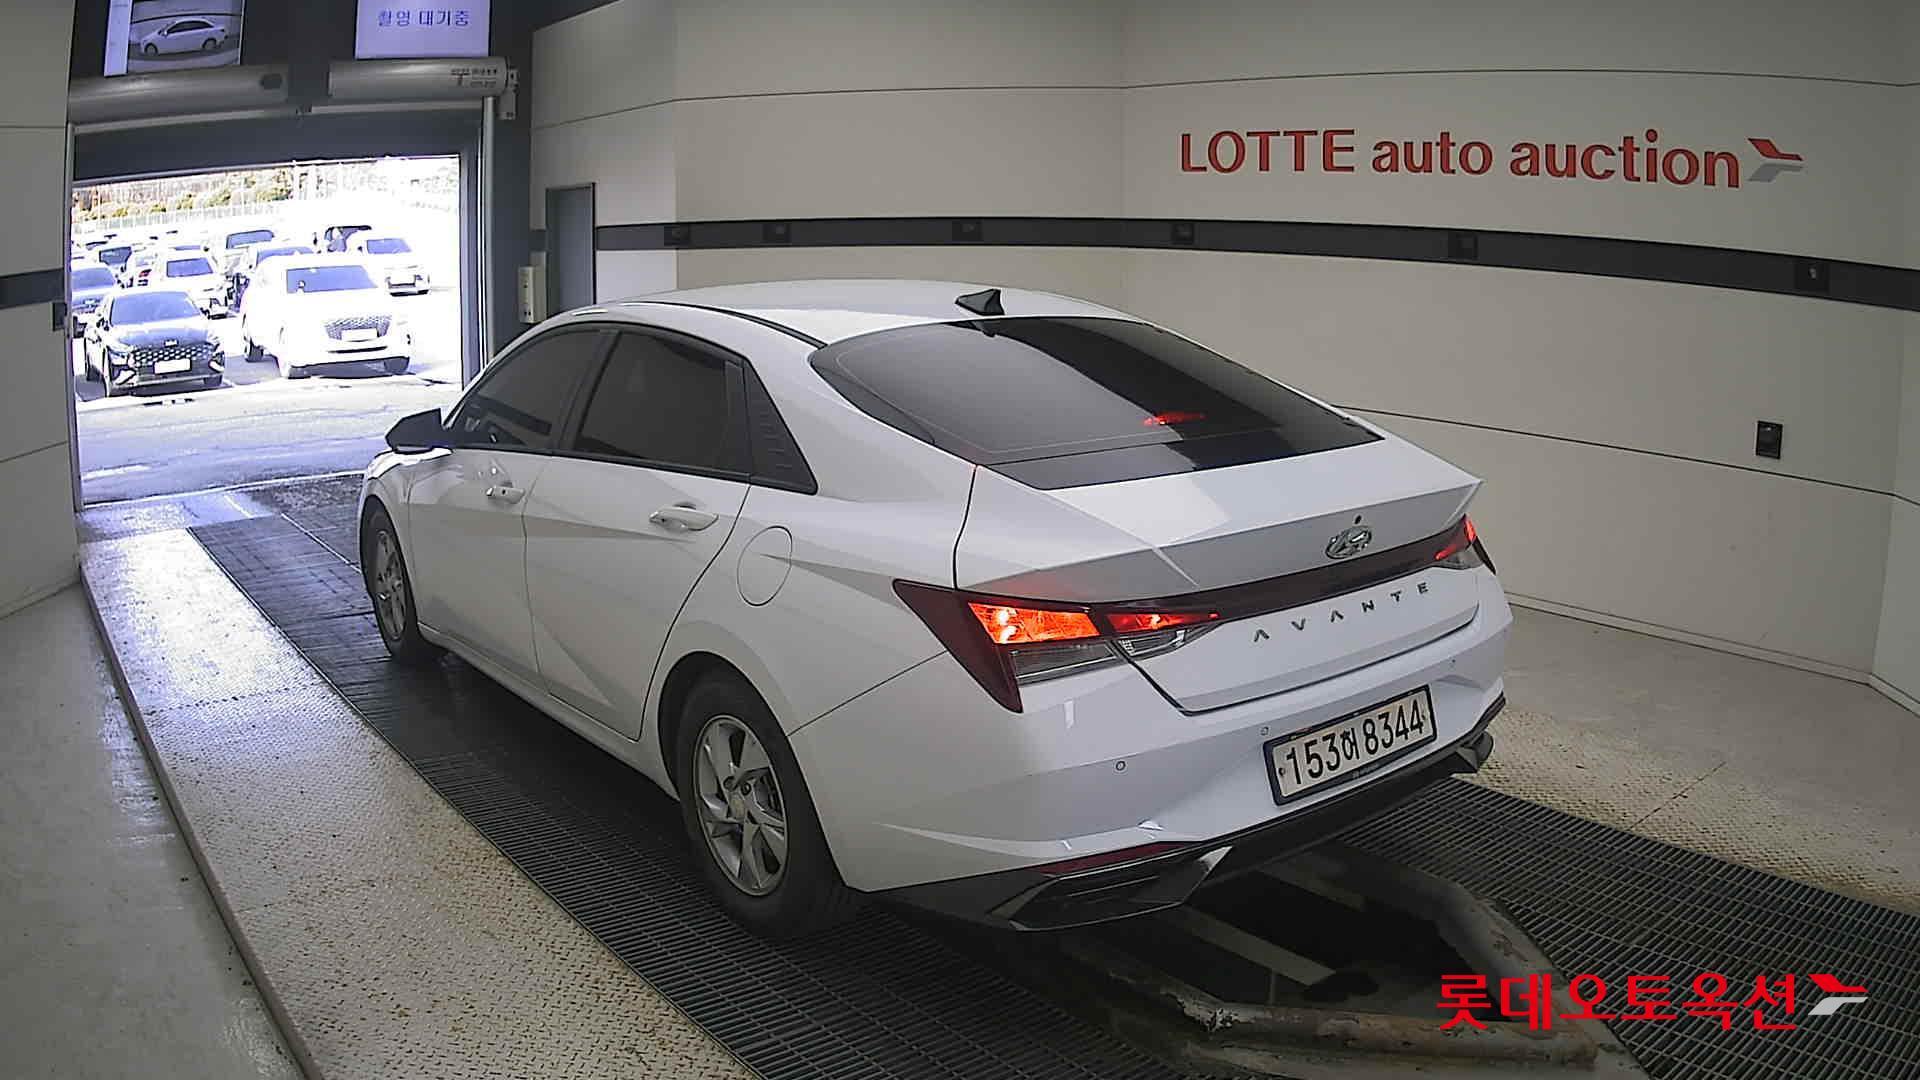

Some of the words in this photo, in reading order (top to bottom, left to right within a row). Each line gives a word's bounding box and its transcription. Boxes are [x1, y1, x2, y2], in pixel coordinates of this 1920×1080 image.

[419, 10, 469, 26] 대기중
[1181, 129, 1355, 173] LOTTE
[1371, 131, 1491, 175] auto
[1509, 128, 1740, 189] auction
[1253, 581, 1429, 643] AVANTE
